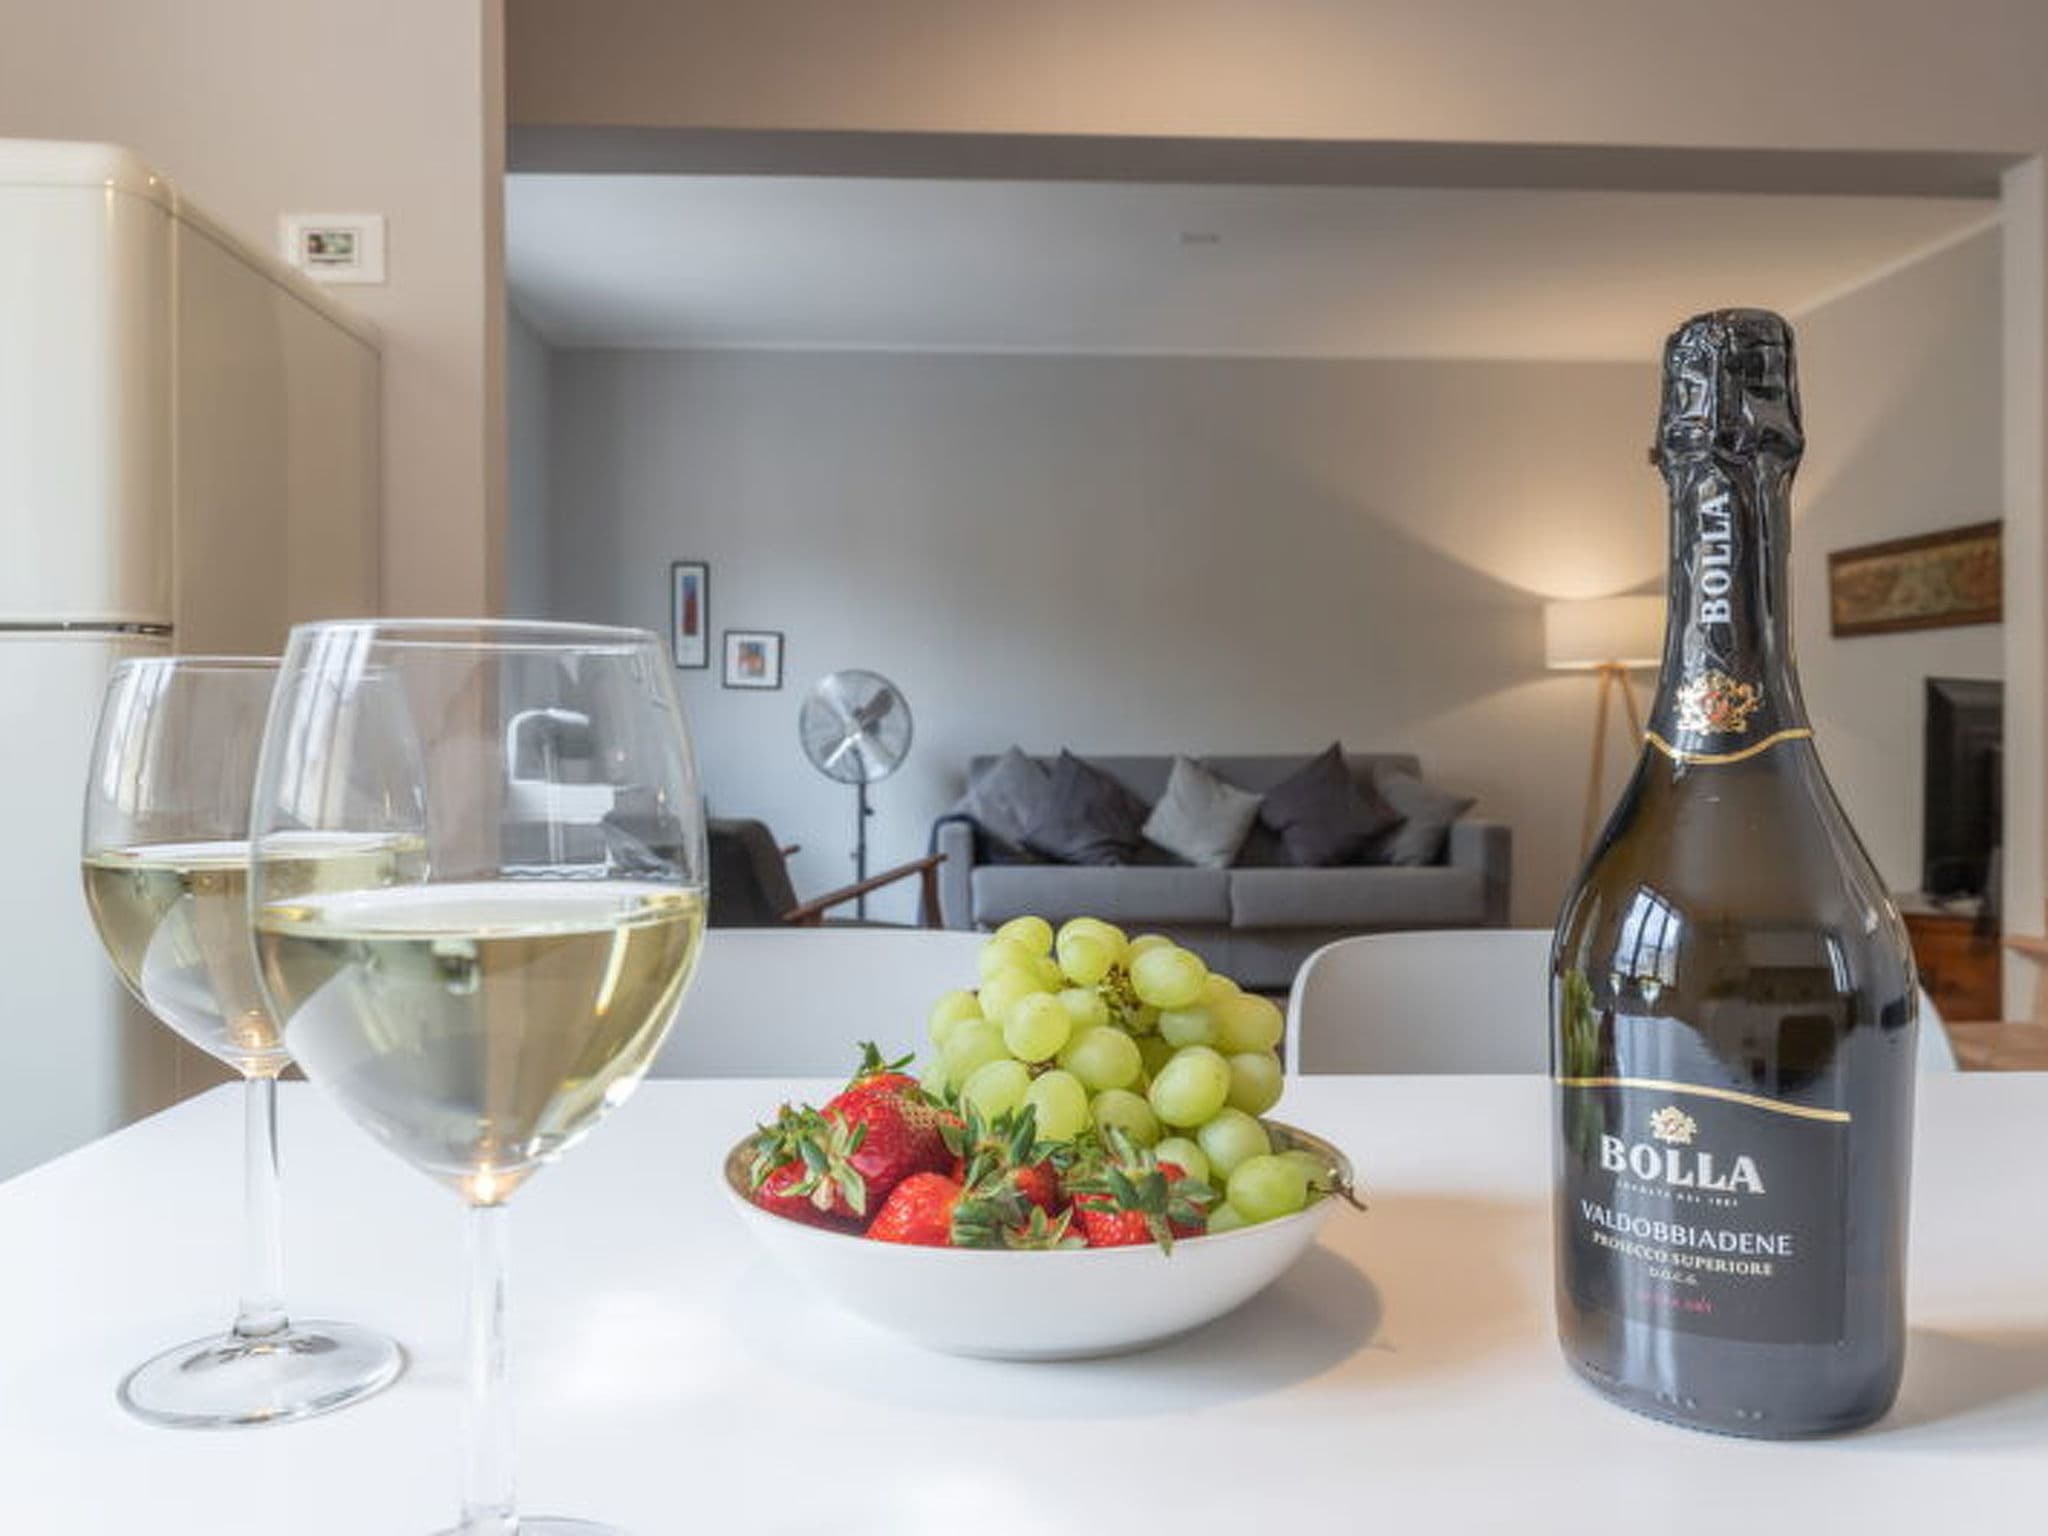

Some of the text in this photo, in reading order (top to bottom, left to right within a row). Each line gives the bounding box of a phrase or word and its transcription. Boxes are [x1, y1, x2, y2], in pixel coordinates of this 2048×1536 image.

[1701, 491, 1732, 624] BOLLA
[1600, 1133, 1766, 1195] BOLLA
[1580, 1200, 1794, 1256] VALDOBBIADENE
[1591, 1230, 1774, 1277] PROSECCO SUPERIORE
